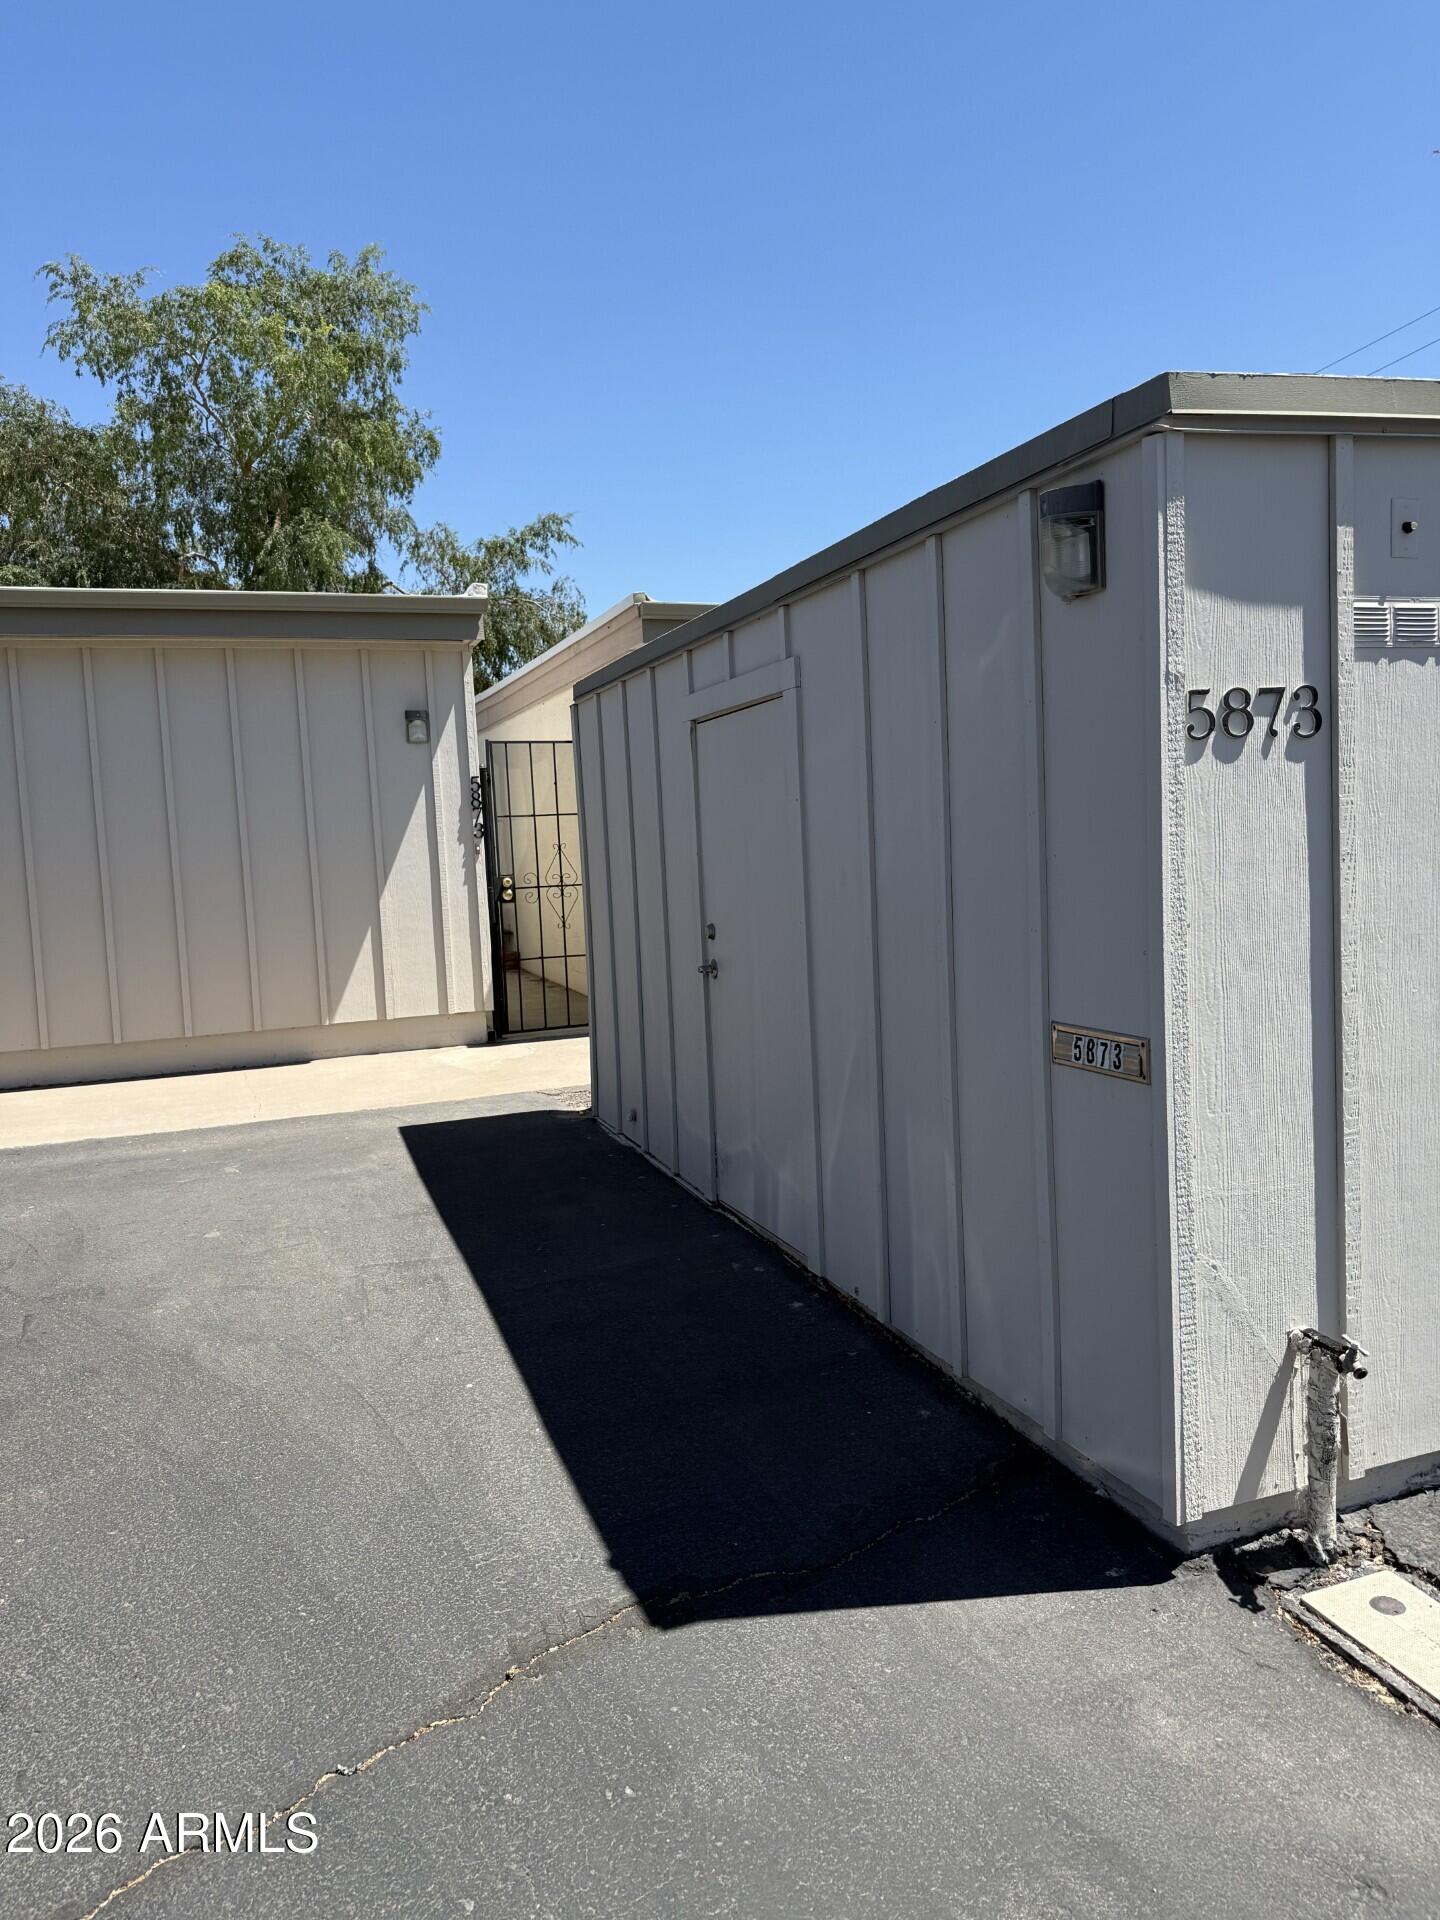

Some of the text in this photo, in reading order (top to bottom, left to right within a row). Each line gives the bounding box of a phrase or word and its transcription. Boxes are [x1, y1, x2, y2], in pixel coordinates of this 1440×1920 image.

[1186, 684, 1323, 740] 5873
[470, 775, 484, 839] 5873
[1073, 1036, 1122, 1070] 5873
